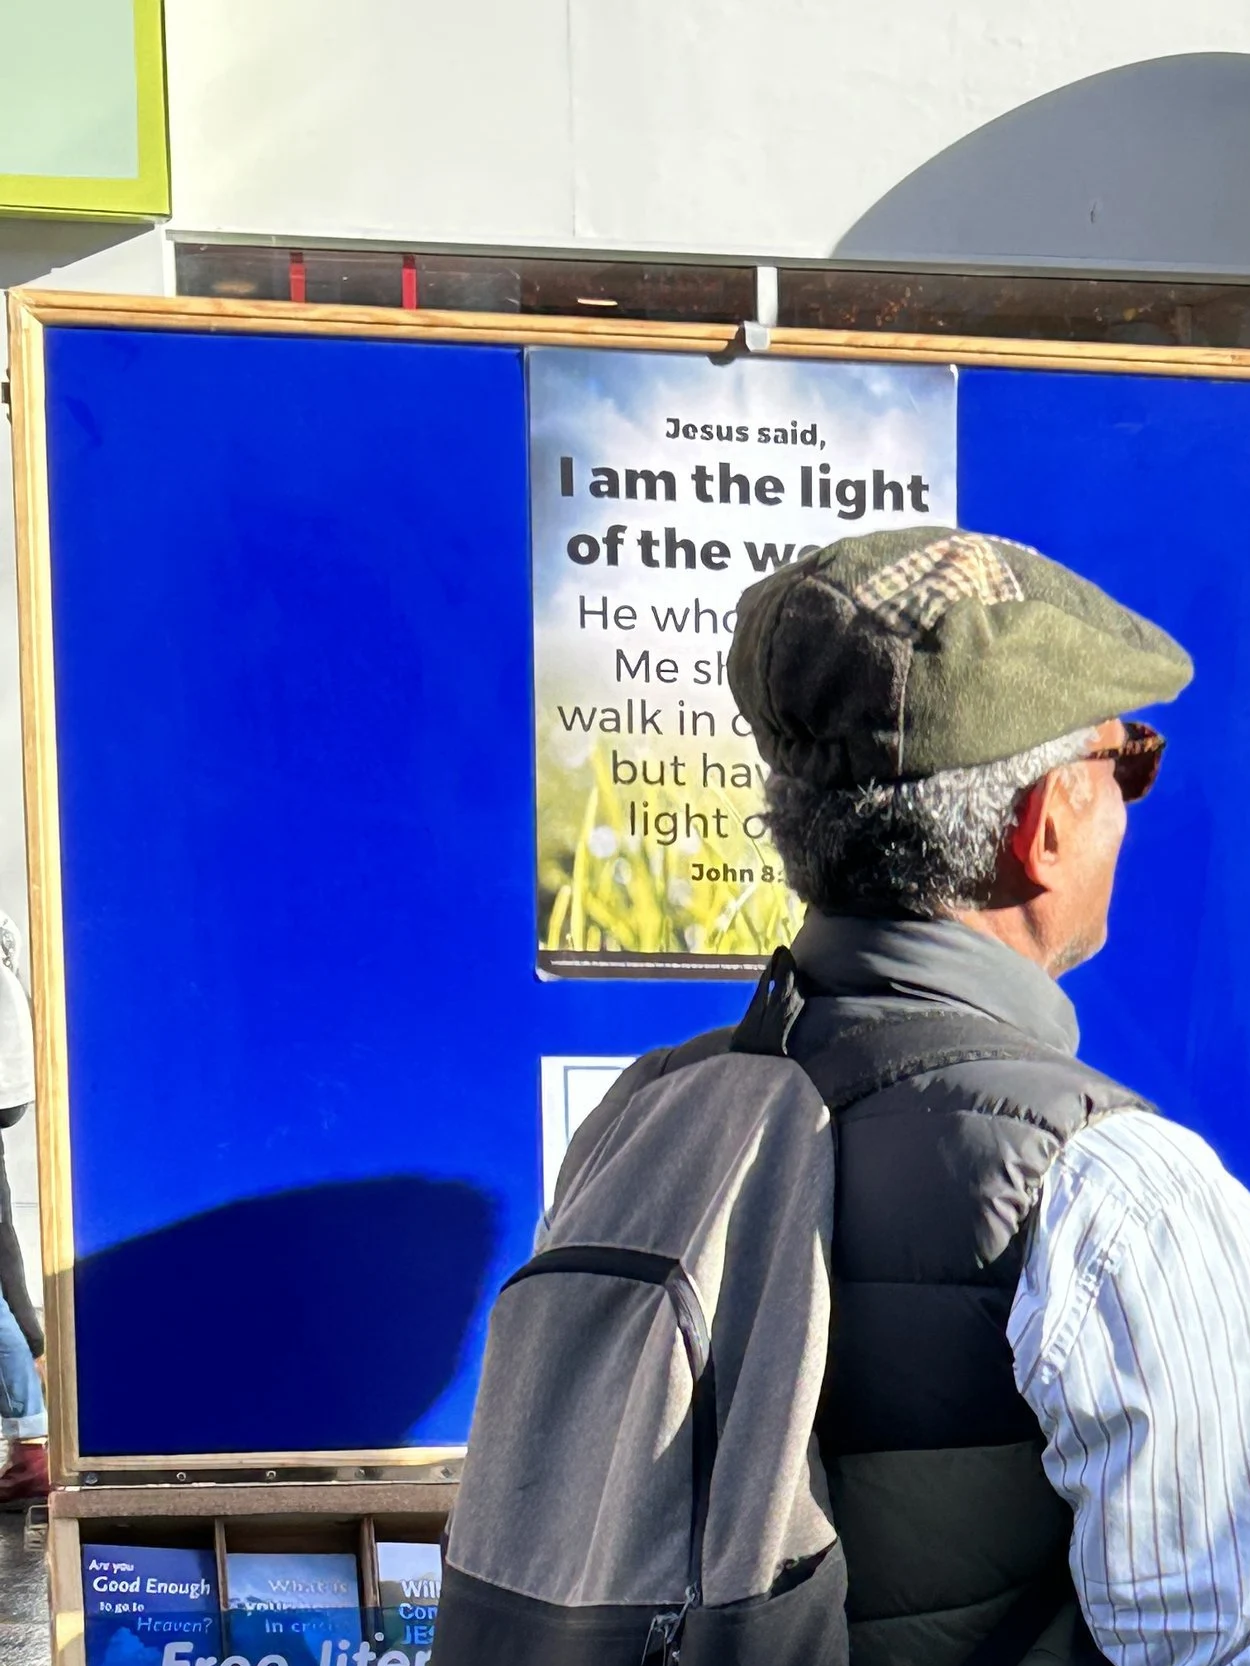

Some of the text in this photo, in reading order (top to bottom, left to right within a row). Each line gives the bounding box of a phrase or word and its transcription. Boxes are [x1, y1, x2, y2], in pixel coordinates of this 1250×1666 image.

[666, 418, 826, 450] Jesus said,
[560, 456, 929, 520] I am the light
[567, 525, 628, 567] of
[637, 527, 731, 571] the
[579, 595, 637, 630] He
[615, 649, 679, 683] Me
[557, 699, 663, 735] walk
[679, 700, 715, 736] in
[612, 750, 686, 786] but
[630, 801, 729, 846] light
[691, 863, 754, 882] John
[89, 1559, 134, 1574] Are you
[93, 1576, 211, 1599] Good Enough
[268, 1580, 348, 1593] What is
[401, 1580, 442, 1598] Will
[100, 1602, 145, 1613] to go to
[137, 1617, 213, 1634] Heaven?
